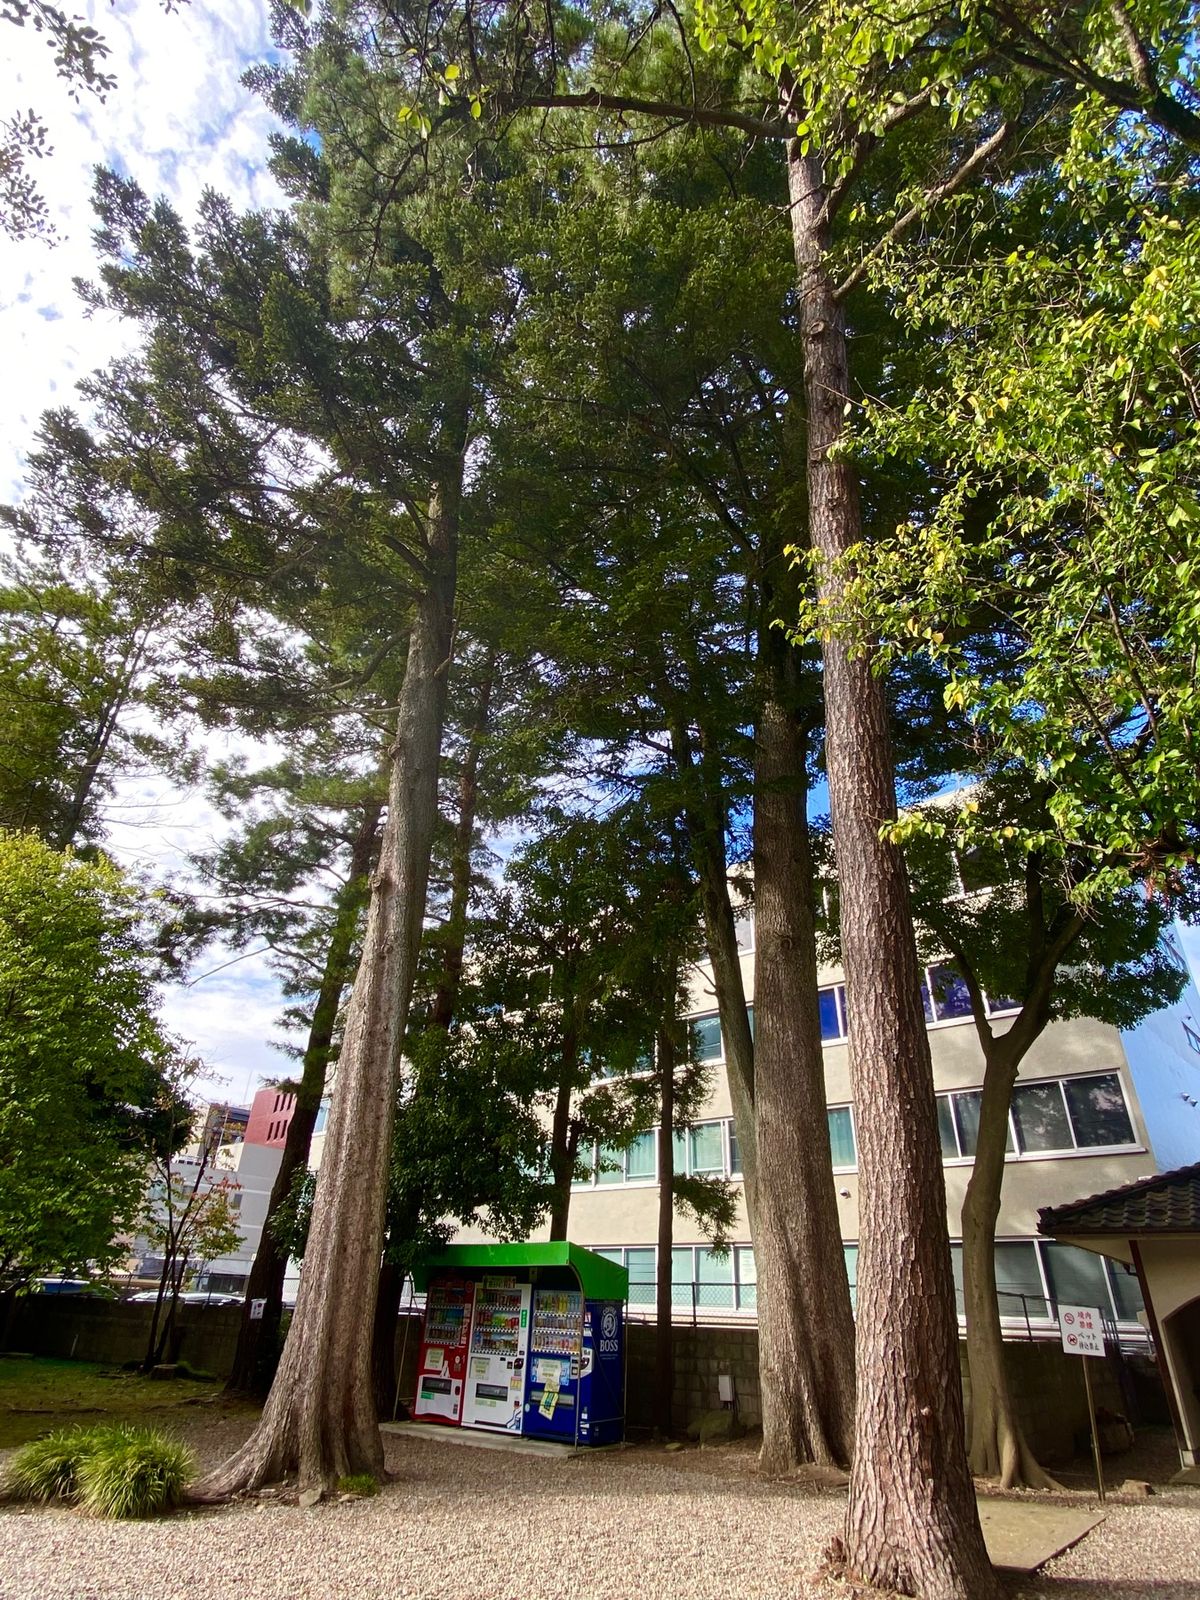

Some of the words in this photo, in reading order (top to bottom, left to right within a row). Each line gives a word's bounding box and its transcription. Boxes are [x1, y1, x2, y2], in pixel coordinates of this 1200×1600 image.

[1078, 1332, 1096, 1340] ペット
[599, 1339, 619, 1352] BOSS
